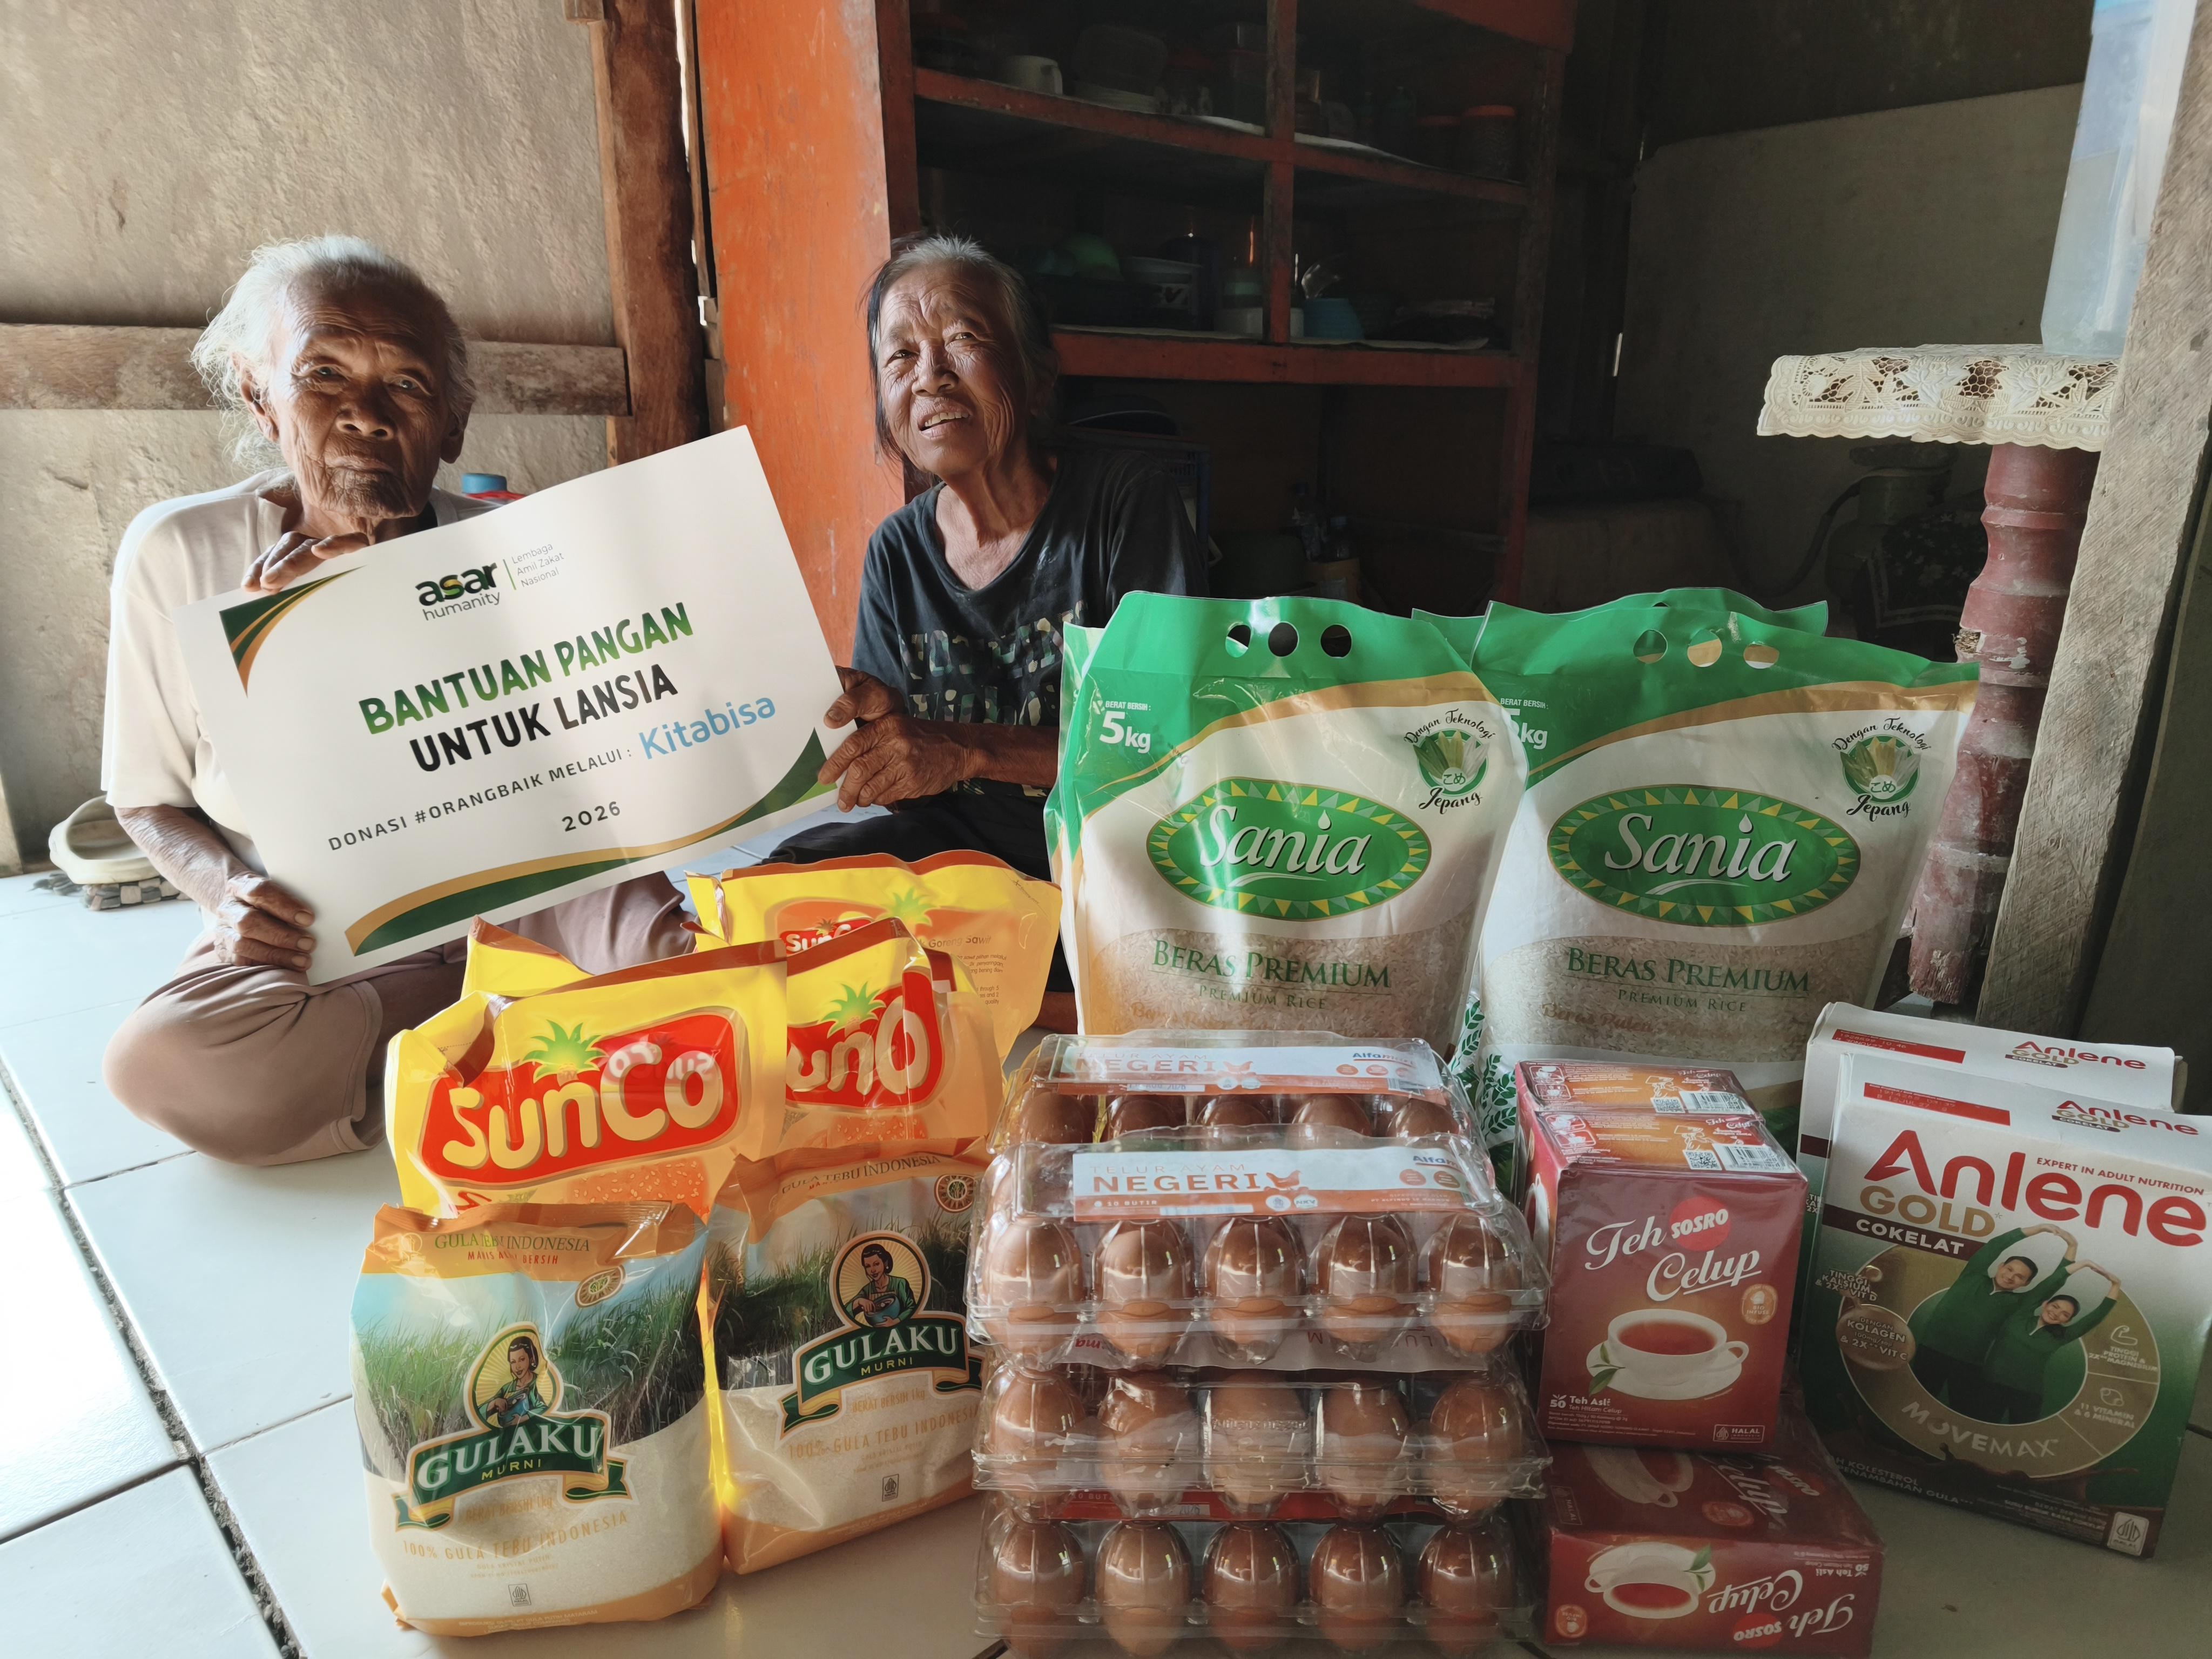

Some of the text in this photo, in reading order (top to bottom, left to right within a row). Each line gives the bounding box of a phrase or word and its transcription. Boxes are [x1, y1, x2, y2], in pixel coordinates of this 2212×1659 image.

[511, 543, 553, 564] Lembaga
[517, 552, 565, 576] Amil Zakat
[415, 562, 497, 606] asar
[521, 567, 559, 588] Nasional
[422, 592, 500, 621] humanity
[359, 602, 694, 735] BANTUAN PANGAN
[1105, 700, 1127, 709] BERAT
[1500, 698, 1522, 706] BERAT
[409, 664, 678, 772] UNTUK LANSIA
[1404, 708, 1496, 744] Dengan Teknologi
[1099, 710, 1151, 754] 5kg
[1831, 717, 1932, 751] Dengan Teknologi
[327, 696, 777, 851] DONASI #ORANGBAIK MELALUI Kitabisa
[1442, 772, 1467, 785] こめ
[1870, 780, 1896, 793] こめ
[1418, 786, 1483, 814] Jepang
[1846, 794, 1912, 822] Jepang
[561, 801, 622, 832] 2026
[1200, 804, 1372, 876] Sania
[1603, 812, 1798, 883] Sania
[928, 937, 963, 948] Goreng
[965, 935, 992, 945] Sawit
[1152, 939, 1391, 989] BERAS PREMIUM
[1566, 947, 1810, 993] BERAS PREMIUM
[1198, 984, 1327, 1010] PREMIUM RICE
[1617, 989, 1746, 1012] PREMIUM RICE
[1075, 1058, 1217, 1072] NEGERI
[2011, 1056, 2058, 1067] COKELAT
[2012, 1049, 2080, 1065] GOLD
[2014, 1041, 2147, 1069] Anlene
[442, 1041, 724, 1170] SunCo
[2056, 1100, 2200, 1136] Anlene
[2056, 1109, 2130, 1129] GOLD
[2059, 1117, 2109, 1131] COKELAT
[781, 1175, 820, 1195] GULA
[823, 1168, 860, 1182] TEBU
[864, 1155, 941, 1177] INDONESIA
[1090, 1163, 1245, 1174] TELUR AYAM
[2036, 1157, 2205, 1196] EXPERT IN ADULT NUTRITION
[1093, 1173, 1261, 1193] NEGERI
[1864, 1129, 2207, 1247] Anlene
[1859, 1185, 1997, 1238] GOLD
[434, 1232, 479, 1250] GULA
[506, 1235, 590, 1252] INDONESIA
[1584, 1209, 1729, 1271] Teh SOSRO
[1855, 1218, 1965, 1256] COKELAT
[522, 1254, 559, 1265] BERSIH
[1646, 1249, 1761, 1301] Celup
[1822, 1274, 1871, 1294] KALSIUM
[1851, 1288, 1867, 1299] VIT
[1869, 1293, 1878, 1301] D
[1847, 1319, 1907, 1343] KOLAGEN
[1860, 1317, 1894, 1331] DENGAN
[804, 1325, 959, 1384] GULAKU
[1840, 1335, 1908, 1361] & VIT C
[2103, 1350, 2139, 1362] PROTEIN
[861, 1357, 913, 1376] MURNI
[2107, 1357, 2158, 1372] MAGNESIUM
[852, 1389, 926, 1413] BERAT BERSIH 1kg
[1549, 1395, 1611, 1408] 50 Teh Asli
[2081, 1402, 2135, 1420] 11 VITAMIN
[1901, 1401, 2056, 1458] MOVEMAX
[2092, 1413, 2136, 1429] MINERAL
[833, 1436, 869, 1453] GULA
[877, 1425, 908, 1445] TEBU
[417, 1423, 598, 1491] GULAKU
[481, 1459, 542, 1481] MURNI
[1848, 1461, 1919, 1486] KOLESTEROL
[403, 1510, 629, 1561] 100% GULA TEBU INDONESIA
[1815, 1568, 1835, 1577] Asli
[1837, 1568, 1853, 1577] Teh
[1708, 1569, 1804, 1614] Celup
[564, 1609, 598, 1618] MATARAM
[1734, 1593, 1855, 1641] Teh SOSRO
